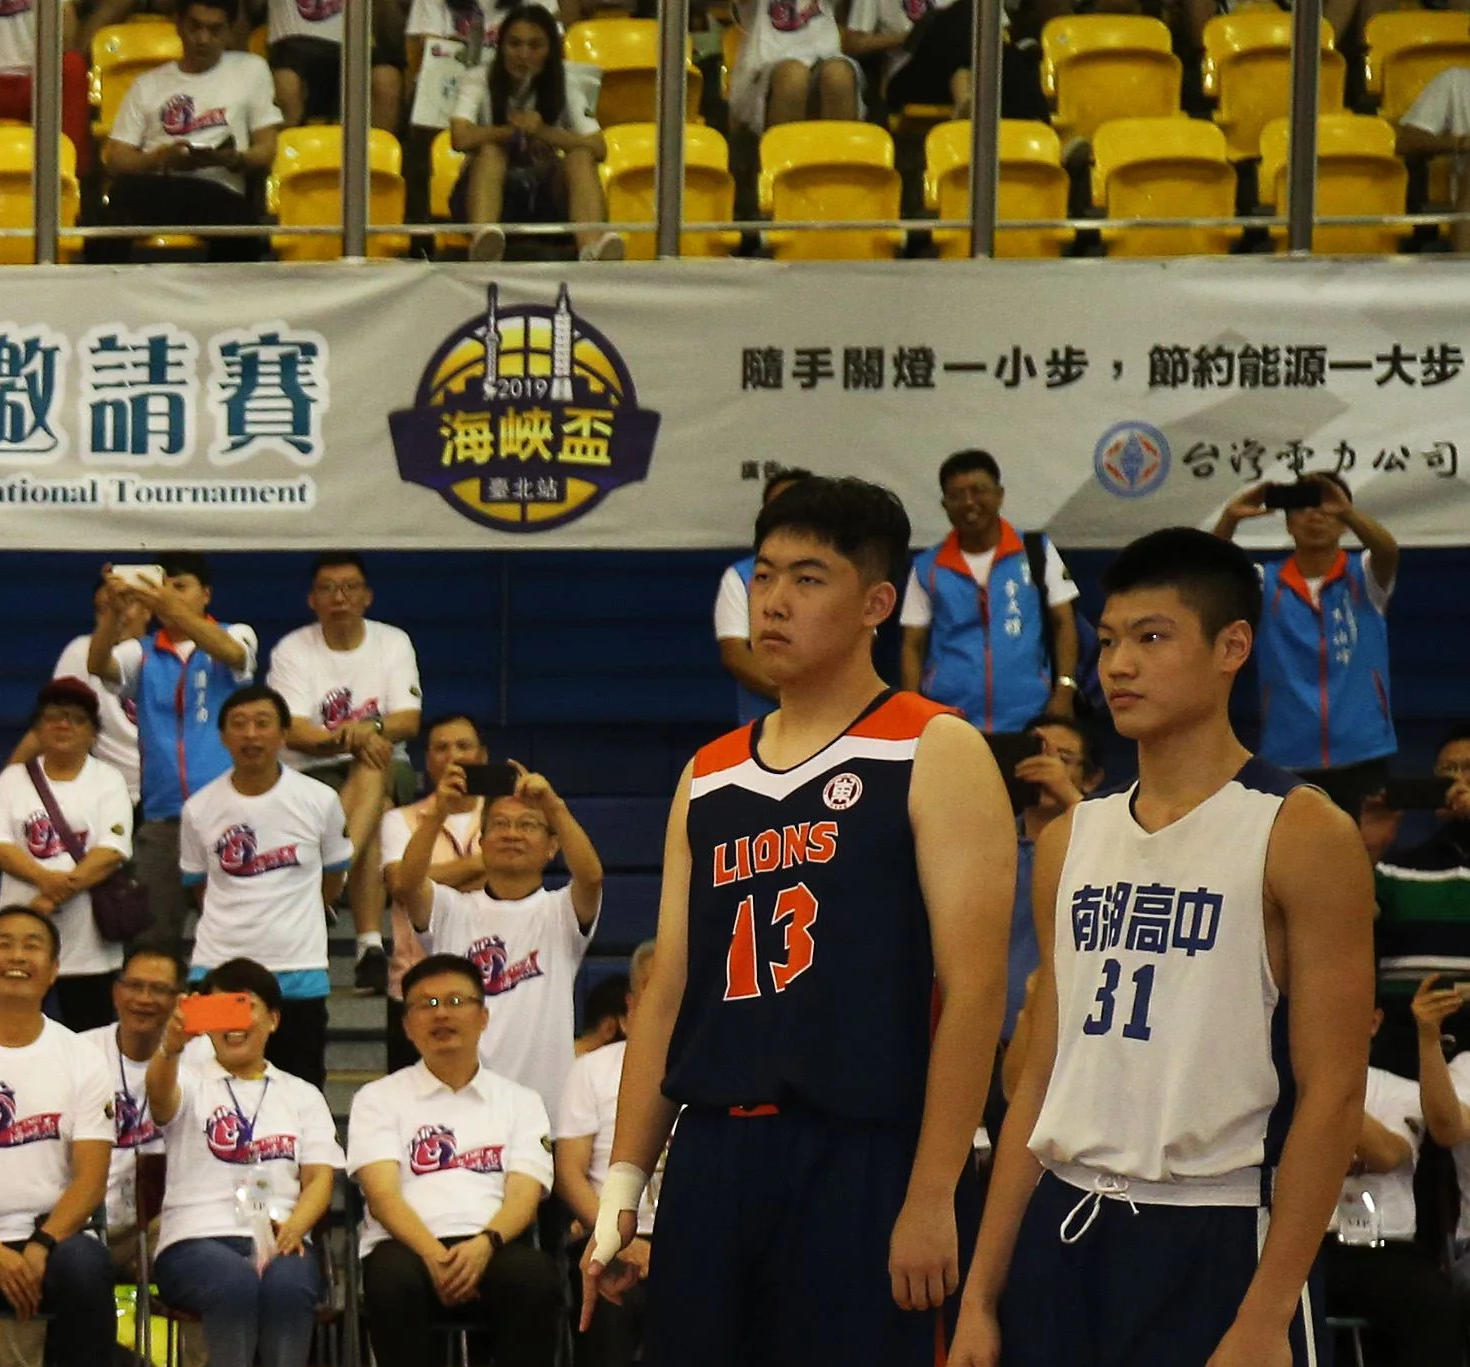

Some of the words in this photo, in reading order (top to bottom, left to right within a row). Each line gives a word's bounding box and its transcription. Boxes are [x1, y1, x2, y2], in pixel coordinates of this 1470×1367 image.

[497, 377, 549, 399] 2019
[439, 405, 615, 467] 海峽盃
[112, 479, 309, 505] Tournament
[712, 820, 839, 888] LIONS
[722, 882, 820, 1002] 13
[1071, 883, 1225, 957] 南湖高中
[1083, 960, 1156, 1042] 31
